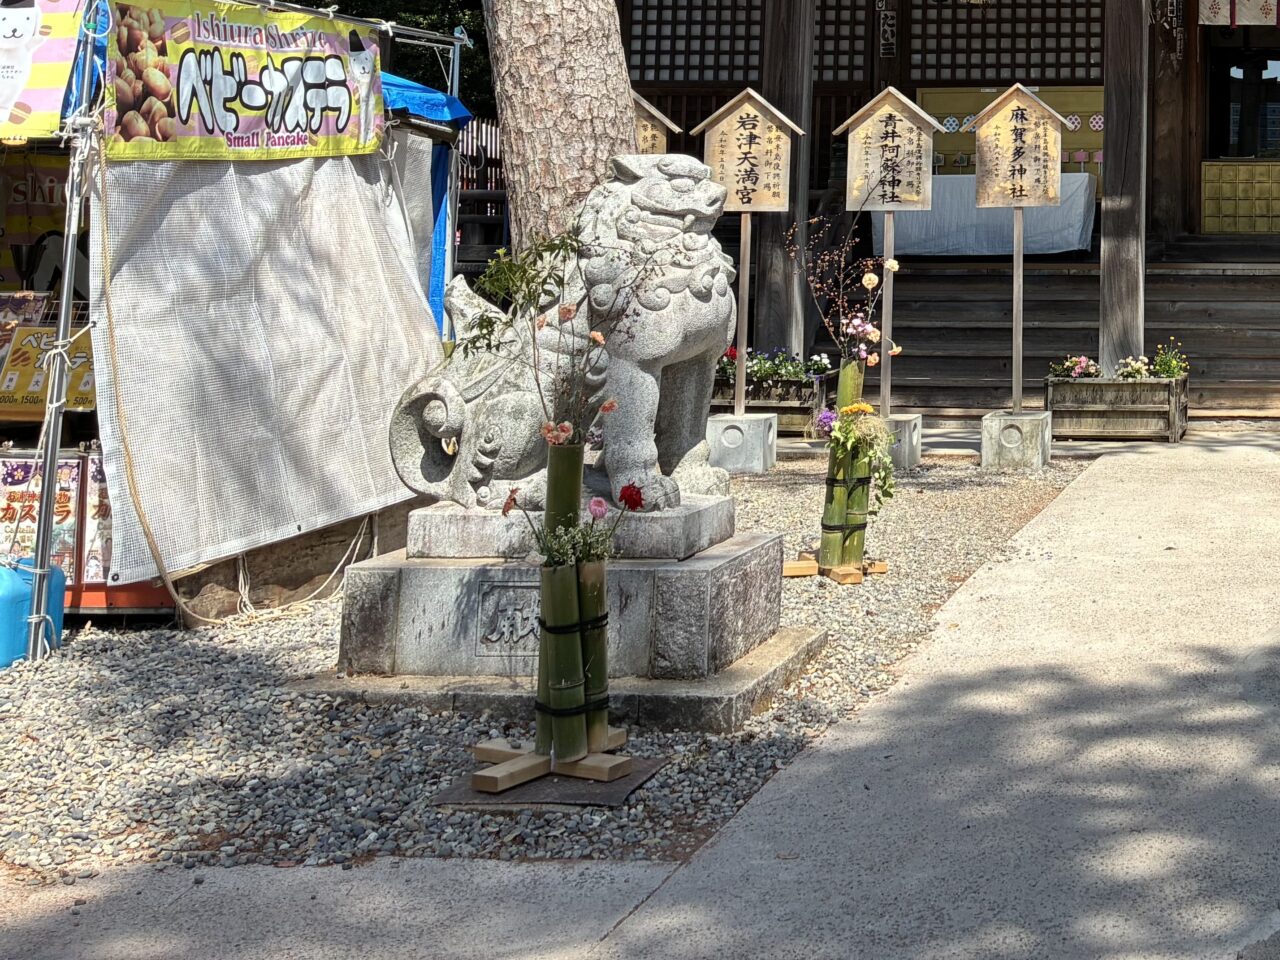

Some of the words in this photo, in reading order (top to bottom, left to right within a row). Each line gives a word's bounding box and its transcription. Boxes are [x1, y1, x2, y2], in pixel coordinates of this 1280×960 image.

[196, 12, 263, 45] Ishiura
[266, 23, 326, 50] Shrine
[177, 46, 351, 135] ベビーカステラ
[225, 131, 260, 148] Small
[265, 130, 309, 148] Pancake
[734, 112, 762, 205] 岩津天満宮
[878, 112, 903, 205] 青井阿蘇神社
[1008, 105, 1029, 199] 麻賀多神社
[0, 503, 72, 525] カスラ
